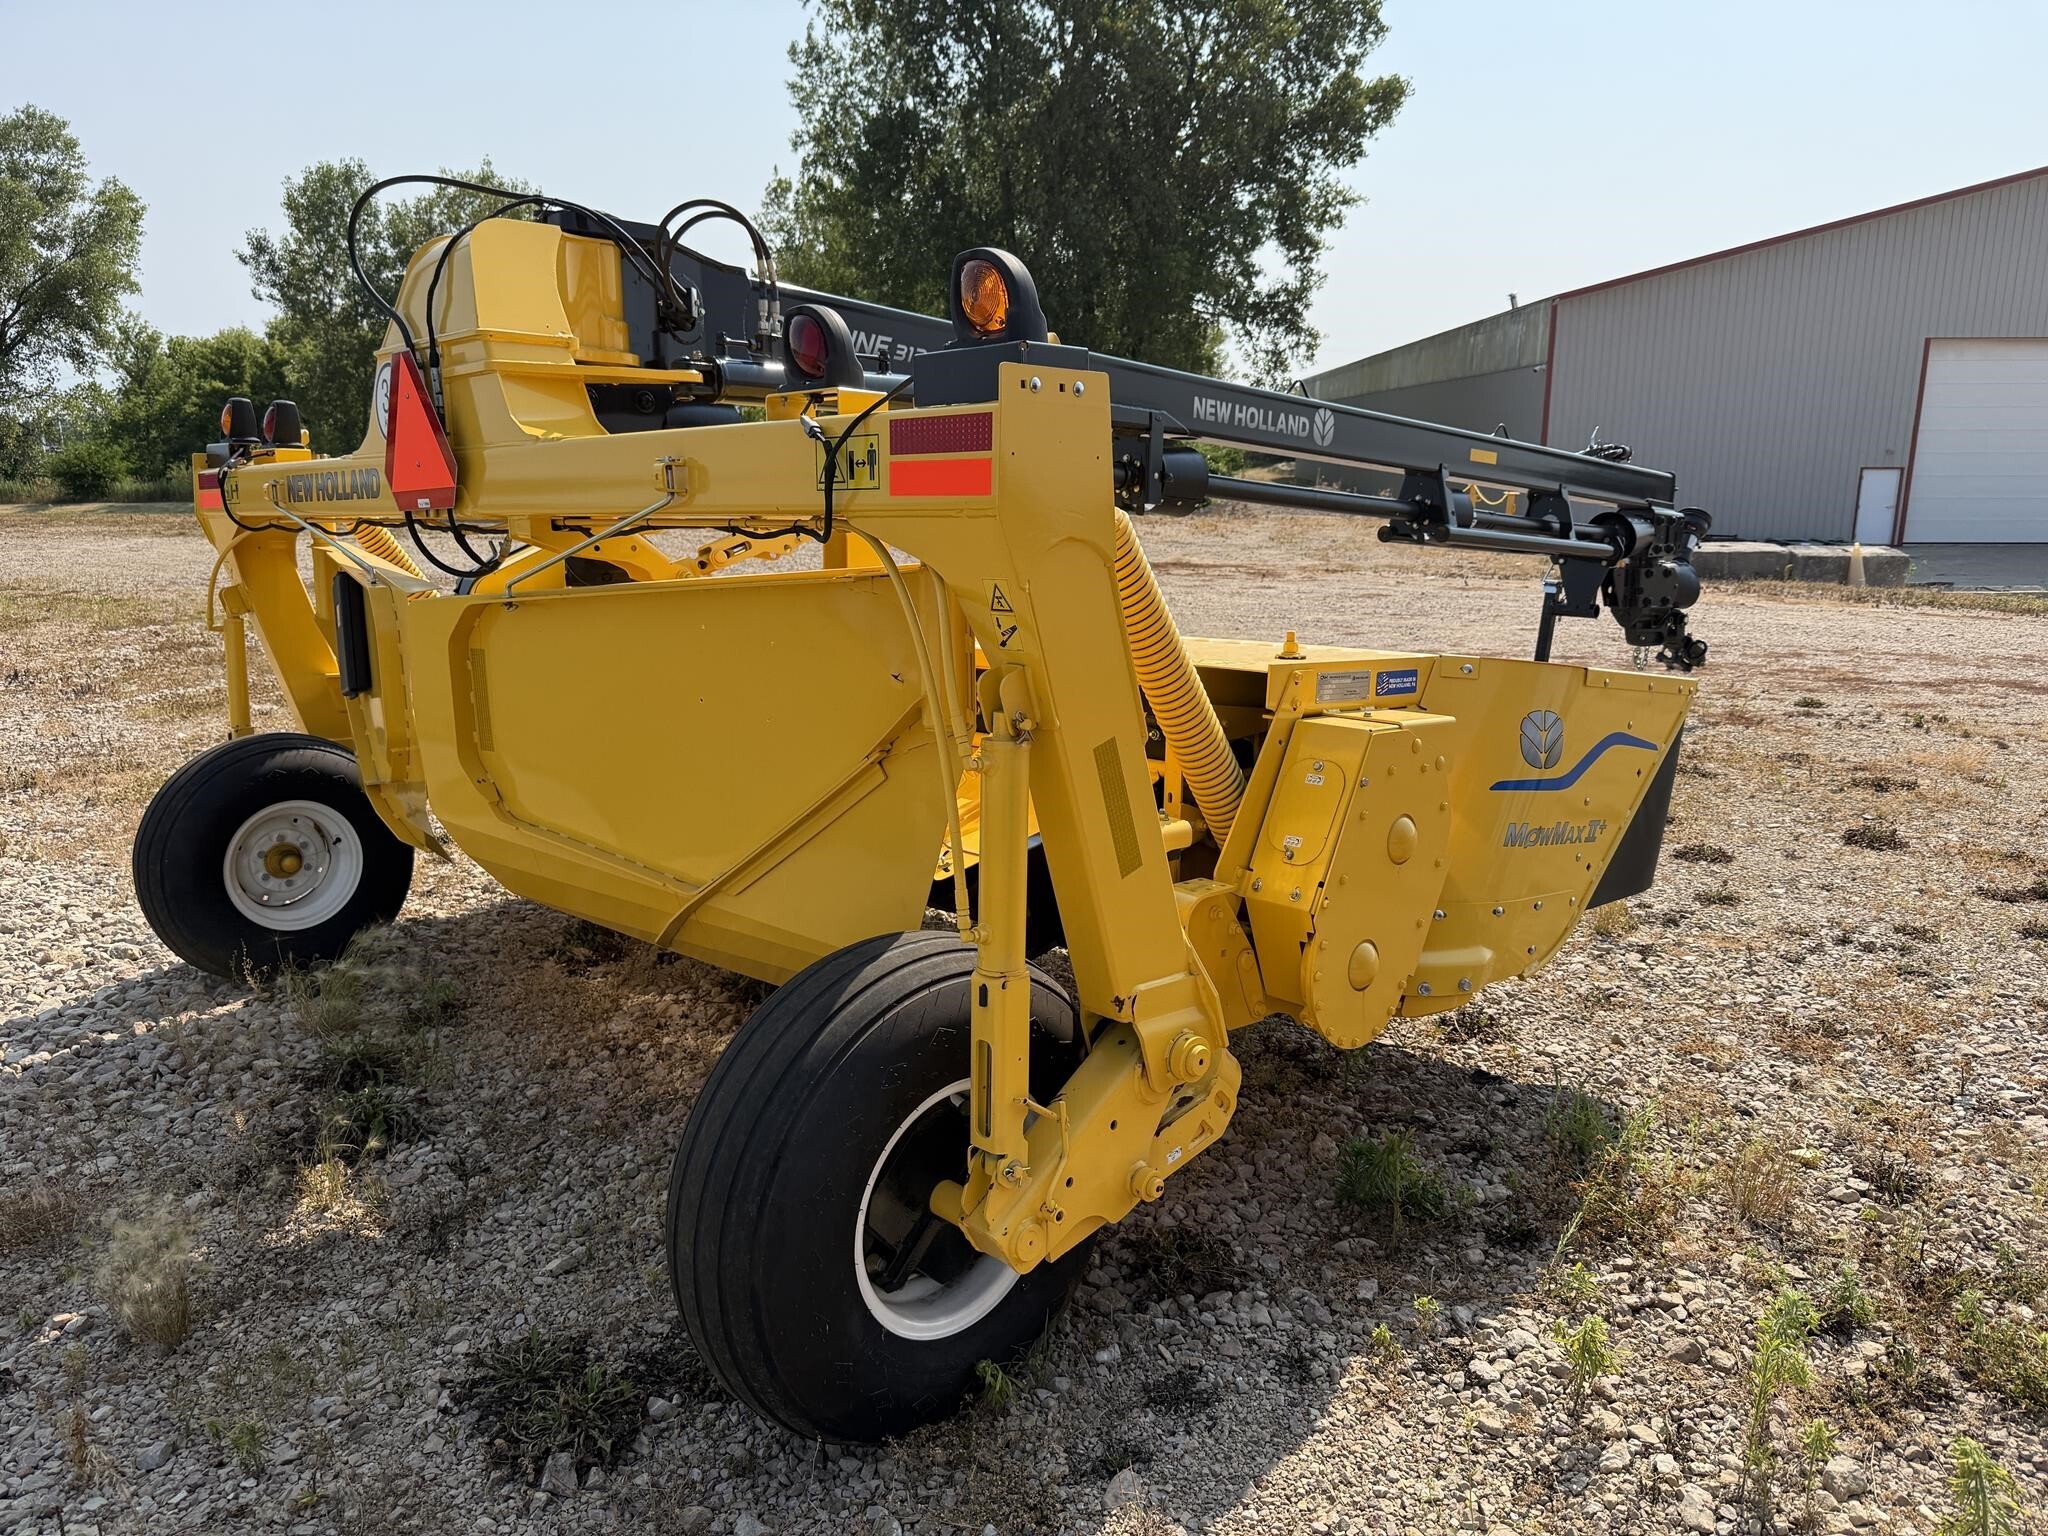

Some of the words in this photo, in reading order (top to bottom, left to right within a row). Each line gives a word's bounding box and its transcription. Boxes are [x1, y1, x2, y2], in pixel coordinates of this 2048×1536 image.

[1192, 395, 1232, 424] NEW
[1234, 404, 1309, 437] HOLLAND
[287, 473, 313, 503] NEW
[315, 467, 380, 502] HOLLAND
